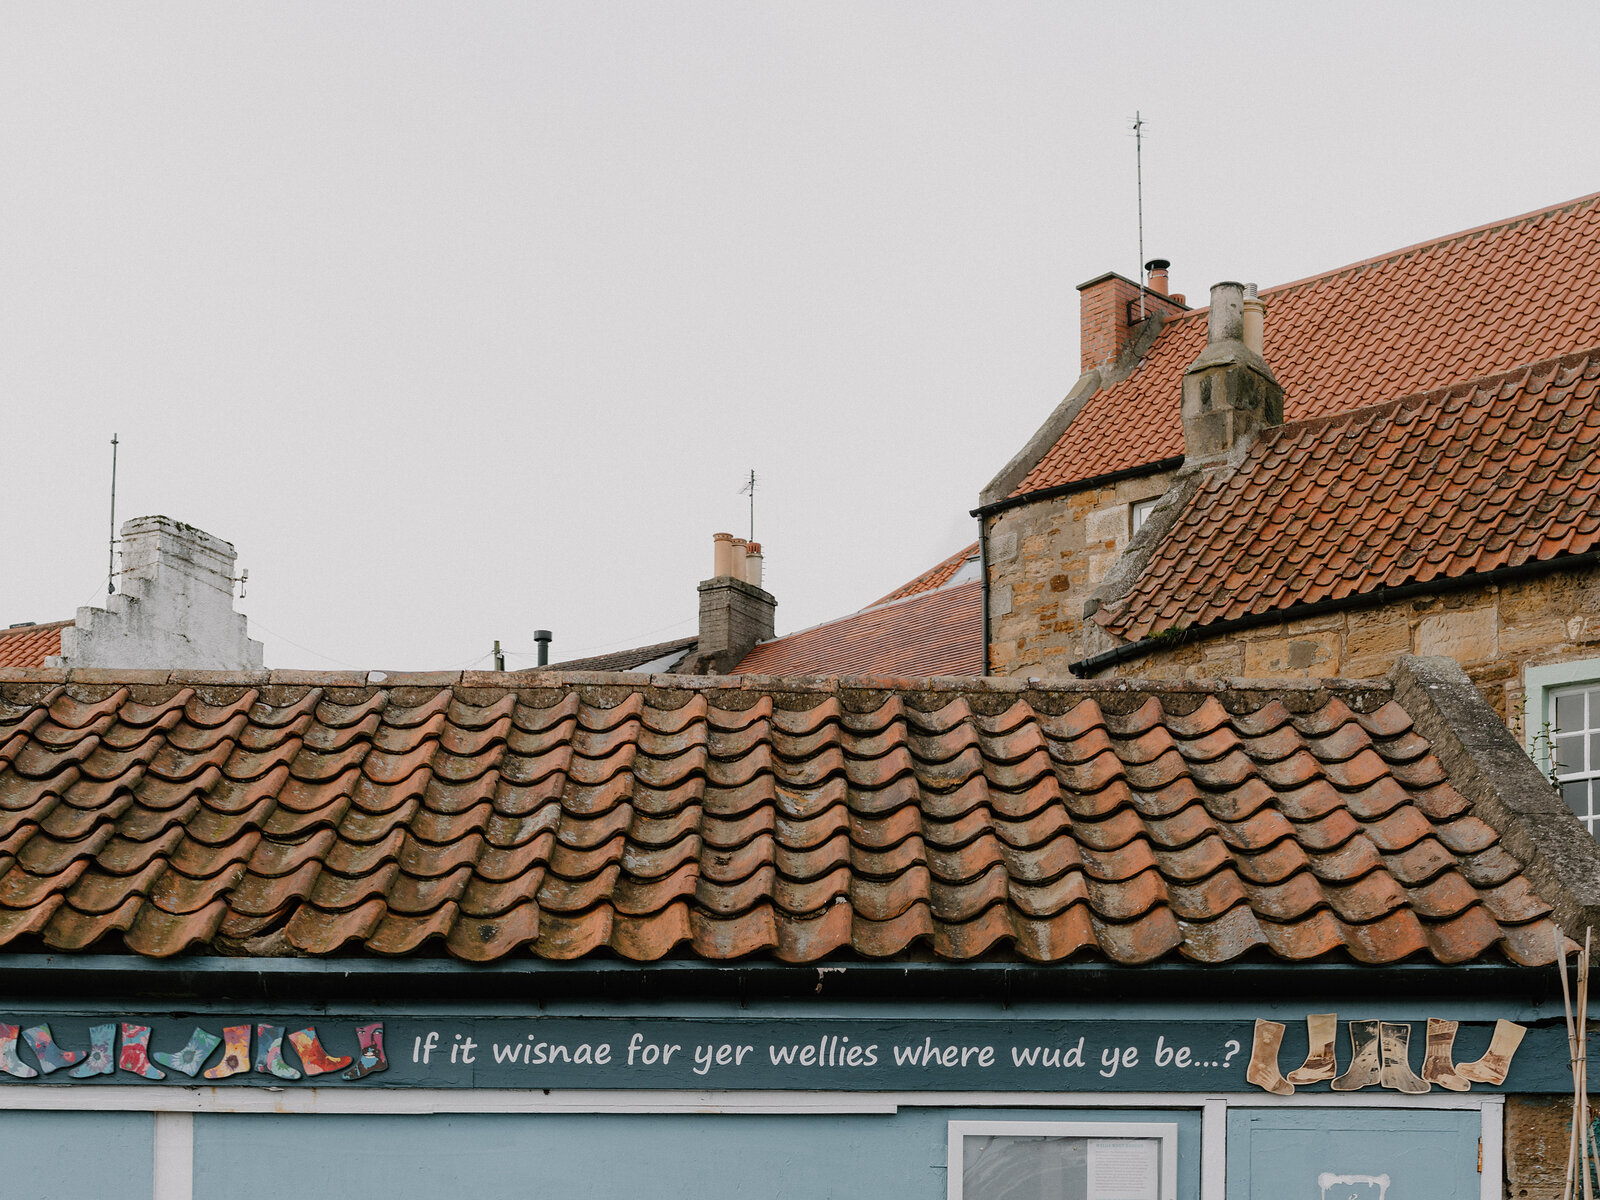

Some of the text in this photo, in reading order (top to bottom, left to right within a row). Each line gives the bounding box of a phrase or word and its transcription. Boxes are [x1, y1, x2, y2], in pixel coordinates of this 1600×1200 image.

[412, 1031, 1241, 1078] If it wisnae for yer wellies where wud ye be...?
